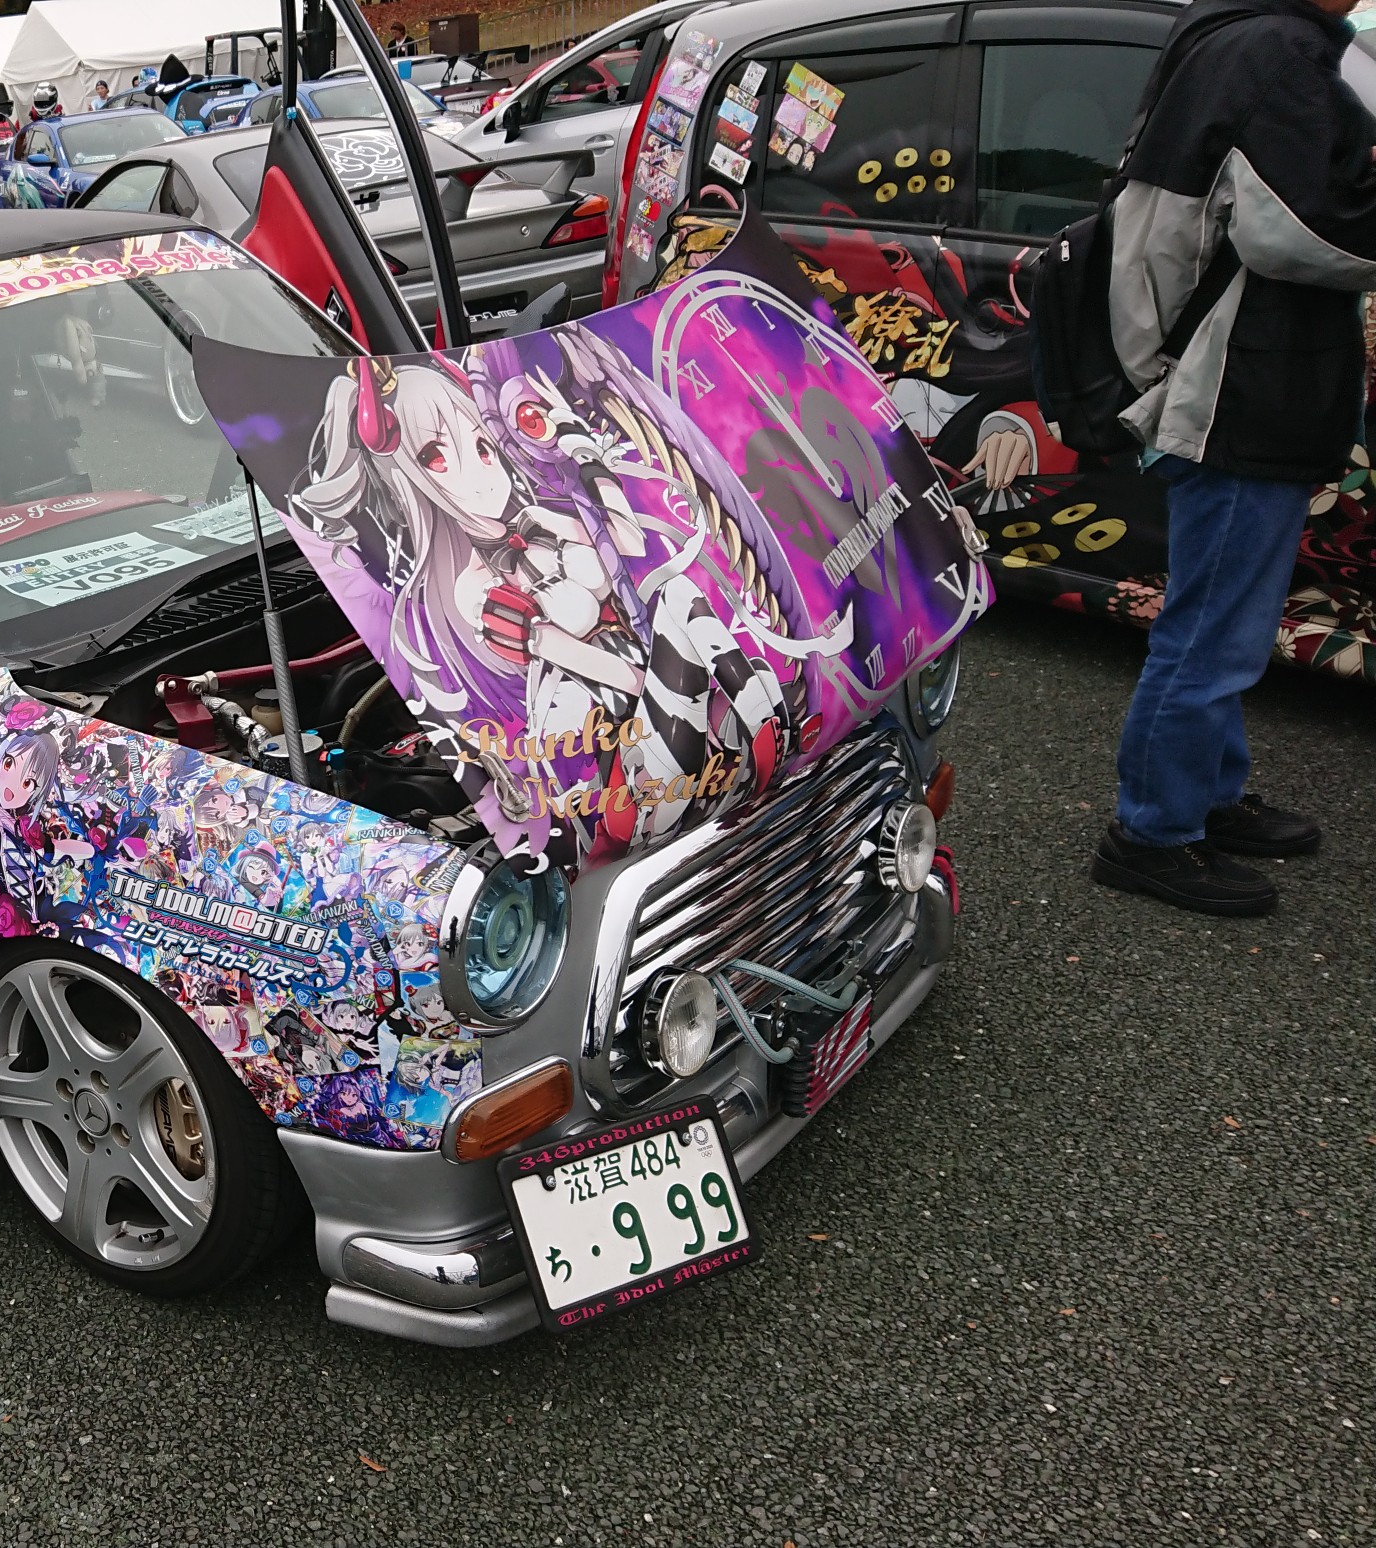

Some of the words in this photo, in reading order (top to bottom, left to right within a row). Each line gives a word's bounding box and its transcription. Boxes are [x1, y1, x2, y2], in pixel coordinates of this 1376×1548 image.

[136, 247, 231, 274] style
[27, 495, 105, 519] Racing
[30, 560, 108, 588] ENTRY
[54, 556, 176, 593] V095
[458, 705, 652, 763] Ranko
[523, 751, 744, 820] Kanzaki
[112, 872, 156, 902] THE
[317, 899, 360, 923] KANZAKI
[122, 920, 307, 987] シンデレラガールズ
[519, 1103, 701, 1171] 346production
[561, 1152, 629, 1204] 滋賀
[630, 1133, 682, 1180] 484
[557, 1302, 607, 1327] The
[614, 1278, 666, 1306] Idol
[673, 1244, 752, 1286] M@ster
